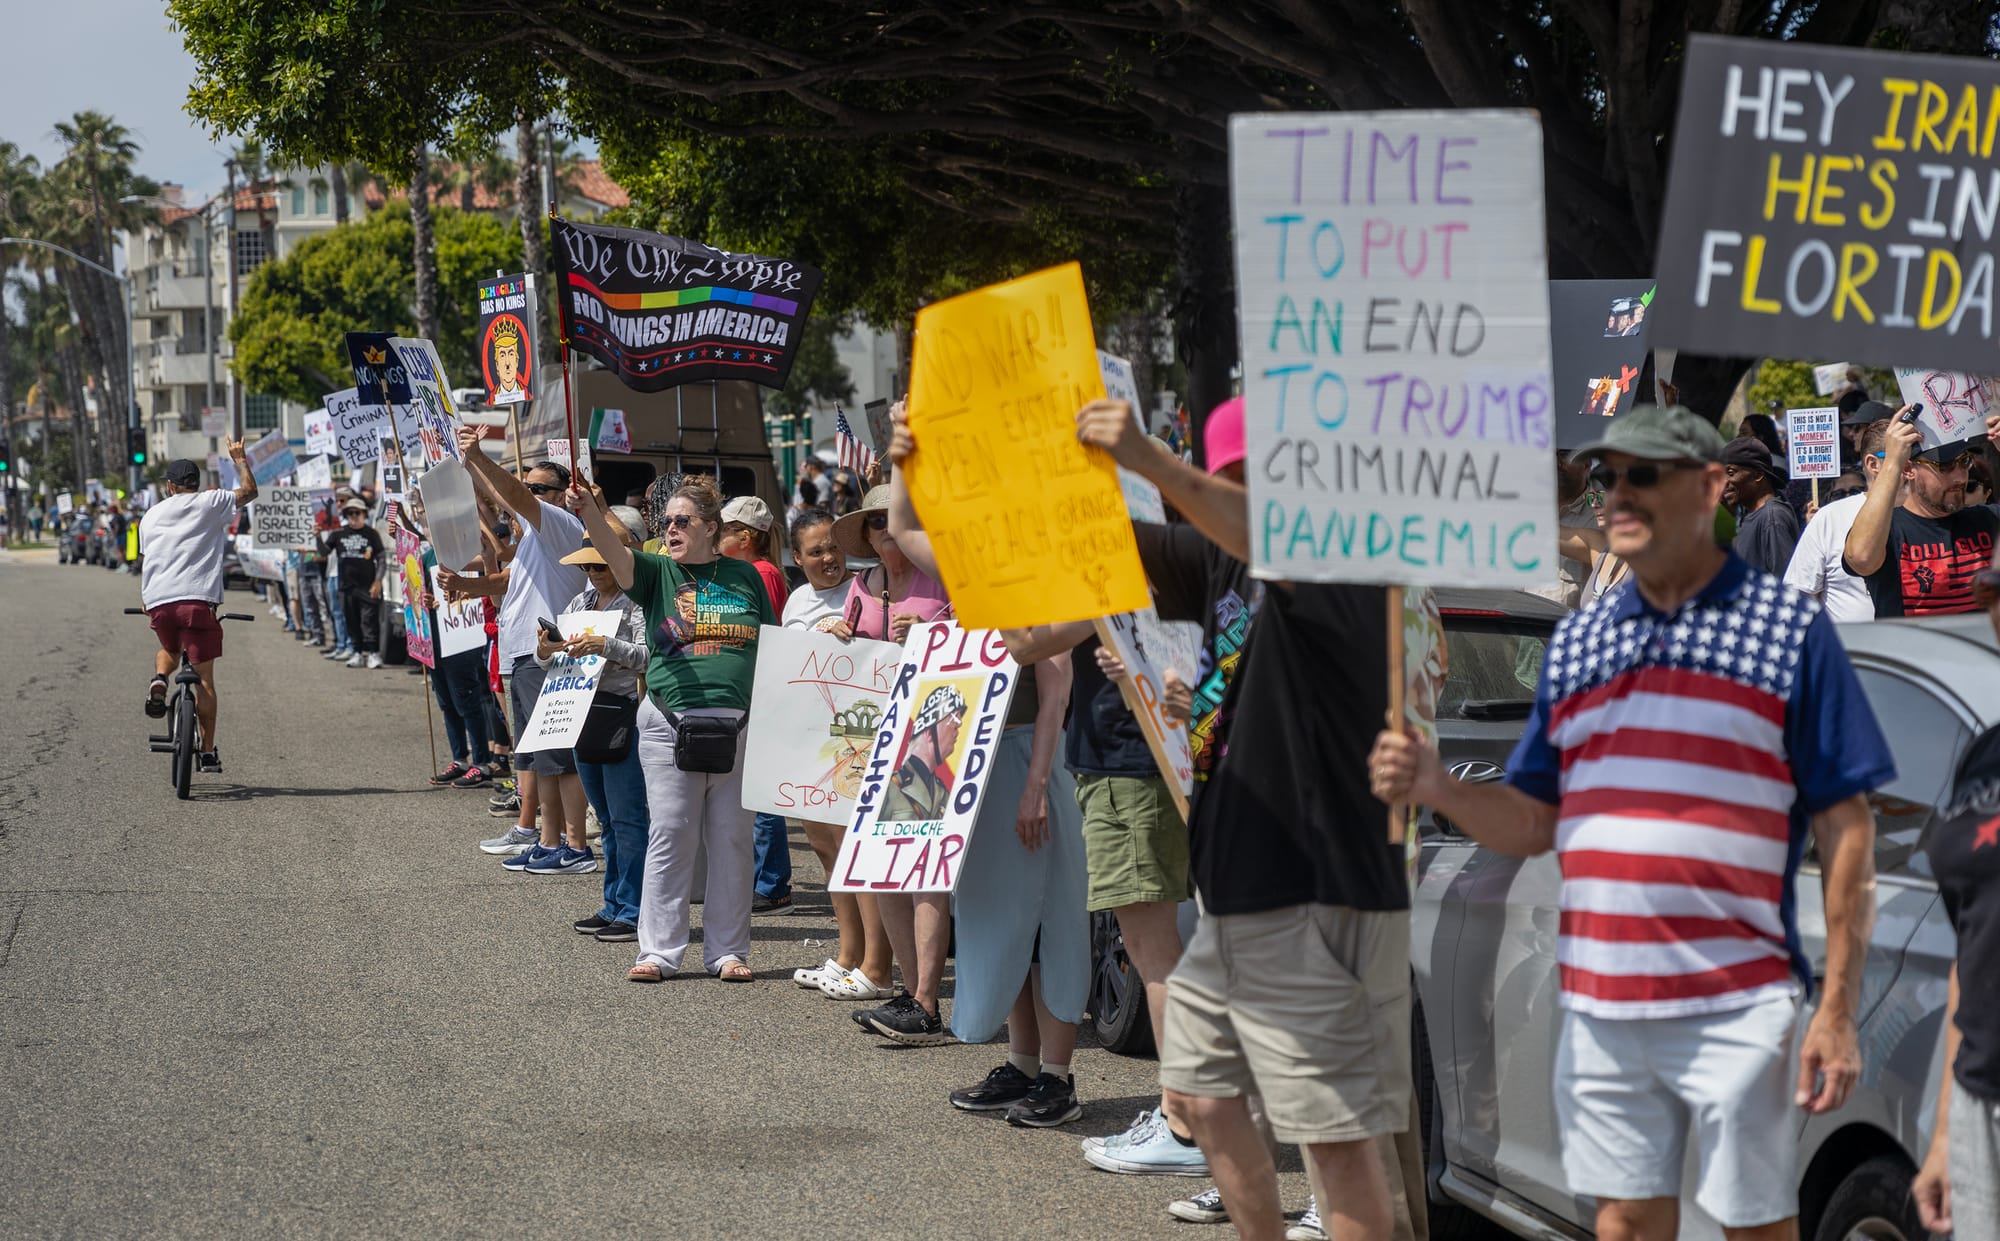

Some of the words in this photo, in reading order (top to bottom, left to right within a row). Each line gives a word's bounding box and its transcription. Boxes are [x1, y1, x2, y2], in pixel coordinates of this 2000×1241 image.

[1720, 64, 1855, 146] HEY
[1264, 127, 1478, 205] TIME
[1764, 152, 1898, 230] HE'S
[1907, 164, 2000, 242] IN
[560, 228, 618, 285] We
[626, 241, 687, 284] The
[1264, 213, 1345, 281] TO
[1359, 219, 1469, 280] PUT
[480, 280, 524, 300] DEMOCRACY
[1694, 229, 1995, 339] FLORIDA
[481, 300, 495, 315] HAS
[495, 298, 505, 313] NO
[506, 294, 526, 312] KINGS
[572, 291, 604, 324] NO
[607, 310, 671, 348] KINGS
[672, 313, 693, 342] IN
[693, 307, 789, 347] AMERICA
[1269, 294, 1344, 357] AN
[1363, 297, 1485, 357] END
[355, 366, 372, 386] NO
[921, 328, 973, 402] NO
[1263, 364, 1348, 432] TO
[1793, 416, 1806, 424] THIS
[1808, 416, 1815, 424] IS
[1815, 415, 1827, 423] NOT
[1793, 424, 1806, 432] LEFT
[1807, 424, 1815, 432] OR
[1816, 423, 1833, 431] RIGHT
[548, 440, 568, 457] STOP
[1796, 446, 1807, 455] IT'S
[1808, 446, 1813, 454] A
[1814, 445, 1832, 453] RIGHT
[1799, 432, 1828, 441] MOMENT
[912, 430, 1001, 507] OPEN
[1264, 437, 1520, 500] CRIMINAL
[1797, 455, 1807, 463] OR
[1808, 454, 1832, 462] WRONG
[1800, 463, 1829, 472] MOMENT
[254, 504, 295, 517] PAYING
[272, 490, 310, 502] DONE
[258, 517, 313, 531] ISRAEL'S
[1056, 489, 1125, 535] ORANGE
[257, 531, 313, 545] CRIMES?
[932, 501, 1051, 590] IMPEACH
[1262, 499, 1541, 572] PANDEMIC
[1901, 542, 1953, 561] SOUL
[1956, 531, 1993, 555] GLO
[697, 592, 748, 608] INJUSTICE
[696, 624, 757, 640] RESISTANCE
[697, 612, 720, 624] LAW
[694, 643, 721, 656] DUTY
[921, 623, 1010, 672] PIG
[800, 650, 854, 682] NO
[541, 676, 593, 697] AMERICA
[921, 684, 956, 714] LOSER
[913, 693, 964, 735] BITCH
[853, 663, 917, 833] RAPIST
[953, 672, 1009, 815] PEDO
[872, 822, 888, 836] IL
[893, 821, 945, 837] DOUCHE
[843, 833, 965, 891] LIAR
